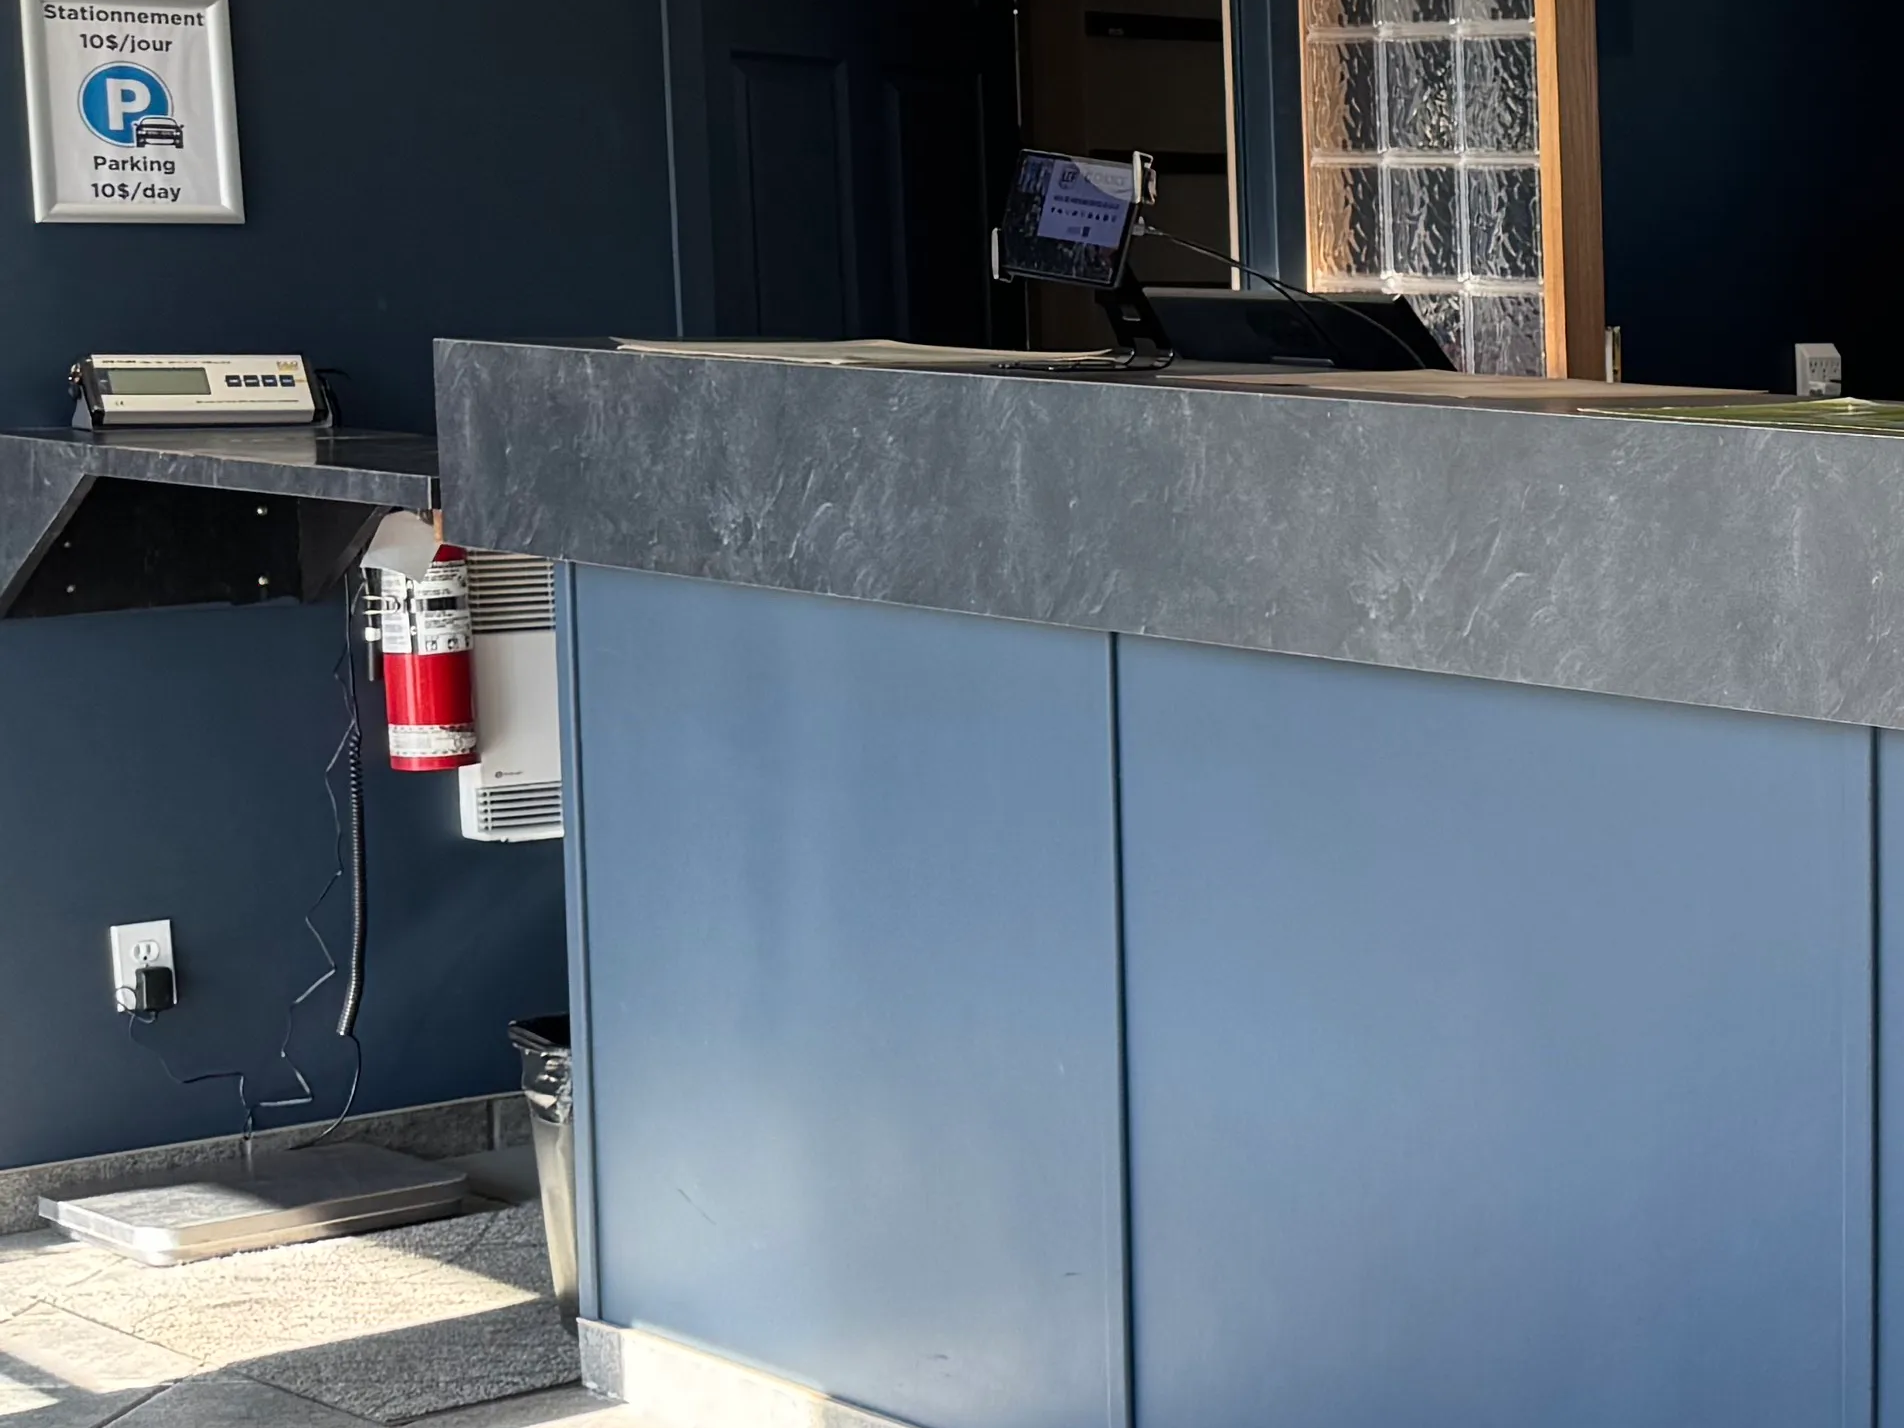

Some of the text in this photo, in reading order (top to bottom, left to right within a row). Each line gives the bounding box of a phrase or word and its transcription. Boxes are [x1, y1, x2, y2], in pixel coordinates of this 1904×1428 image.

[43, 3, 205, 27] Stationnement
[79, 33, 173, 53] 10$/jour
[106, 77, 151, 131] P
[93, 155, 176, 174] Parking
[90, 182, 181, 202] 10$/day
